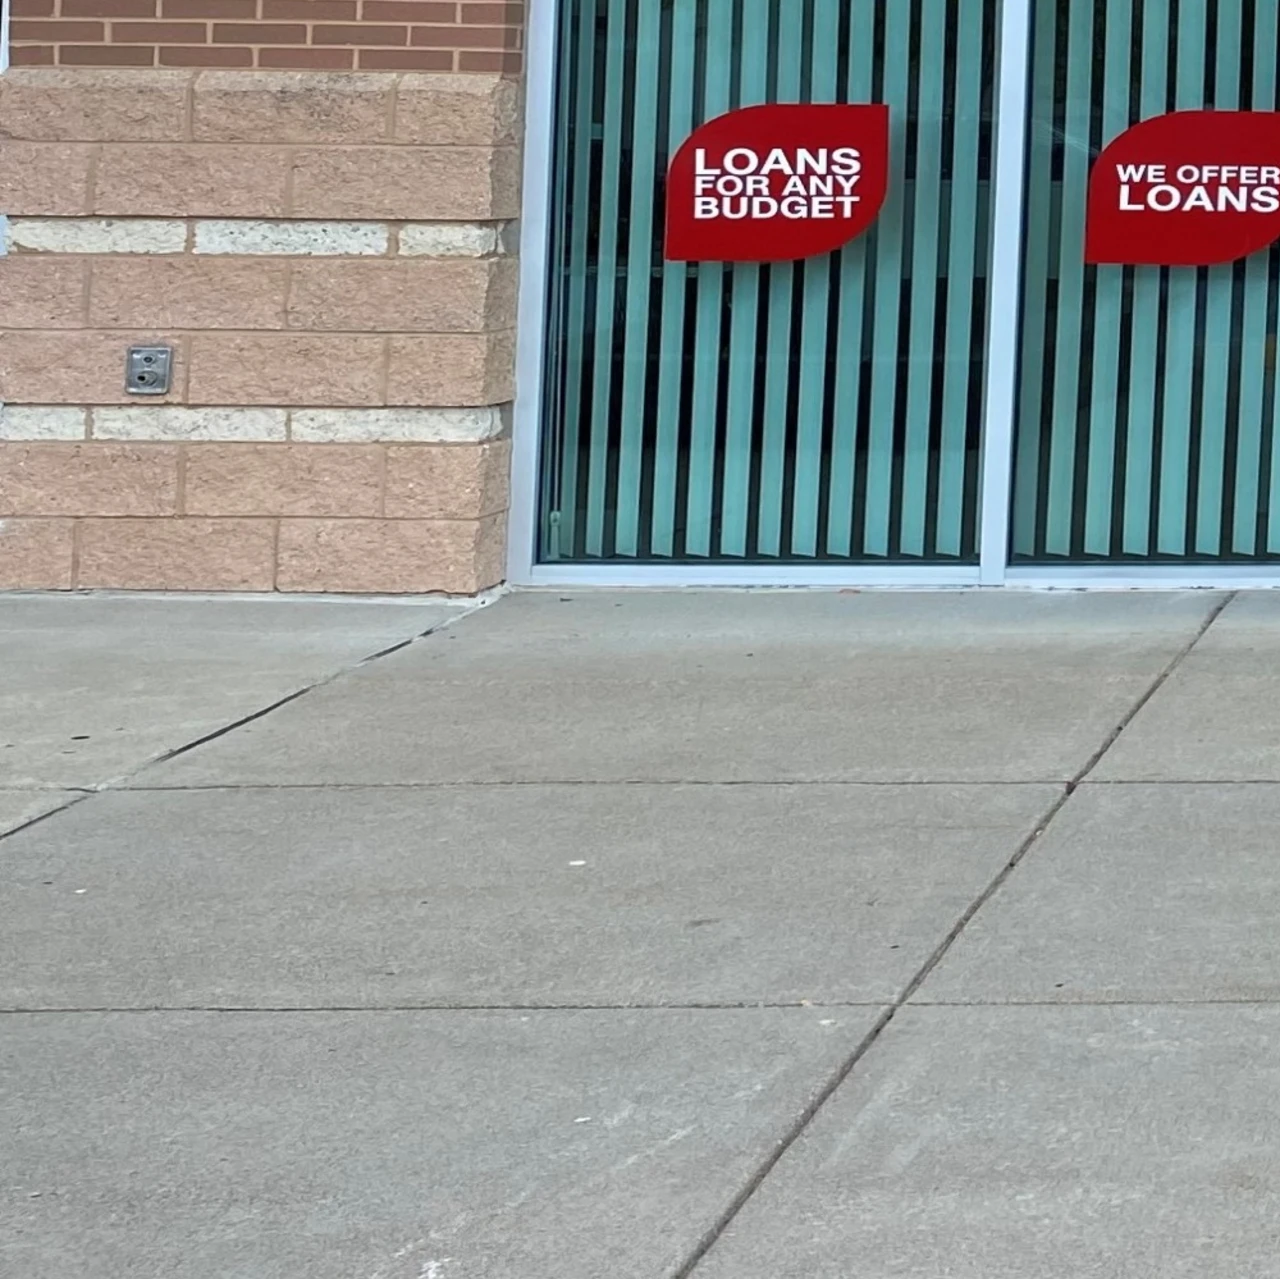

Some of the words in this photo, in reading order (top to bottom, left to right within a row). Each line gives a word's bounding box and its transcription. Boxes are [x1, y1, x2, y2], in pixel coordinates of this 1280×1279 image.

[694, 147, 862, 176] LOANS
[694, 175, 769, 196] FOR
[780, 175, 860, 197] ANY
[1116, 163, 1164, 184] WE
[1175, 164, 1280, 186] OFFER
[693, 194, 861, 219] BUDGET
[1118, 184, 1280, 214] LOANS
